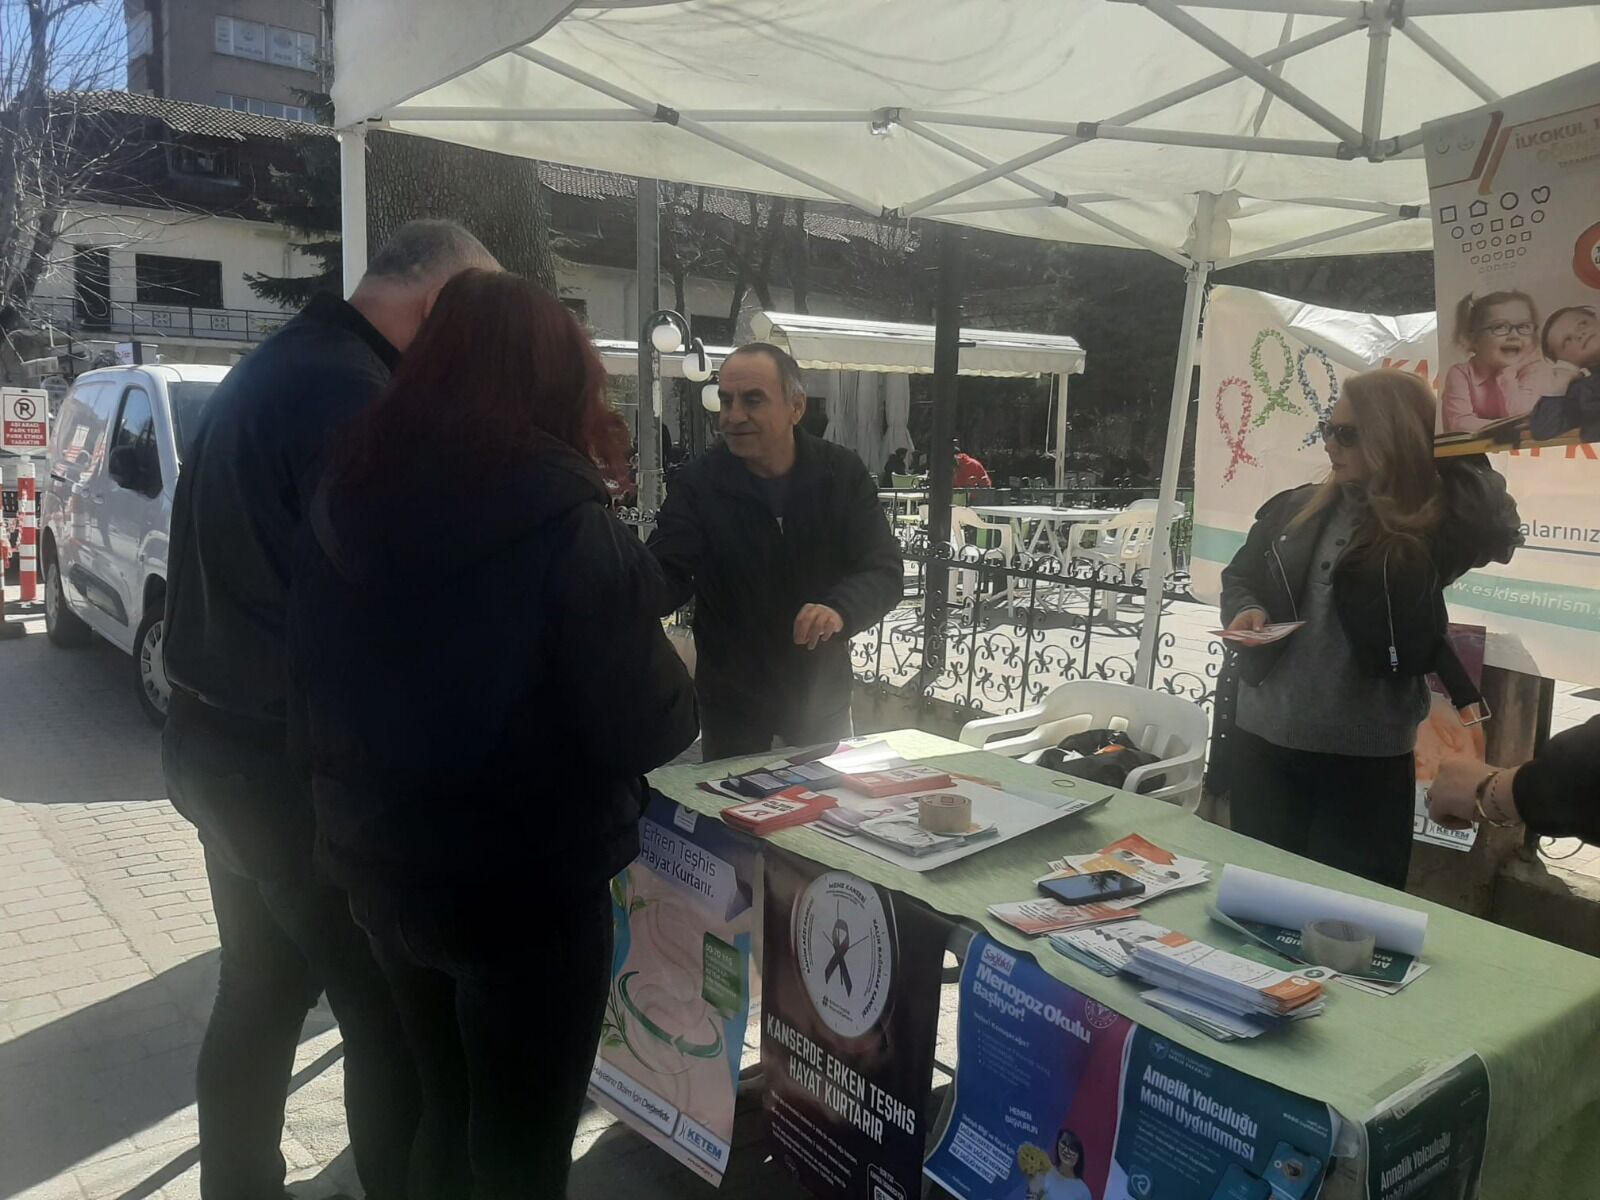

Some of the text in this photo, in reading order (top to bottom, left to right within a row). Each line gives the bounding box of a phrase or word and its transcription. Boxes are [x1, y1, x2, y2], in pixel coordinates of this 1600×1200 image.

[1515, 121, 1587, 149] İLKOKUL
[641, 843, 714, 898] Hayat Kurtarır.
[643, 822, 716, 877] Erken Teşhis
[972, 980, 1026, 1022] Başlıyor!
[976, 963, 1092, 1044] Menopoz Okulu
[766, 1012, 916, 1136] KANSERDE ERKEN TEŞHİS
[789, 1055, 822, 1097] HAYAT
[824, 1082, 884, 1145] KURTARIR
[1140, 1085, 1173, 1117] Mobil
[1175, 1103, 1255, 1162] Uygulaması
[1143, 1064, 1190, 1104] Annelik
[1192, 1088, 1258, 1140] Yolculuğu
[687, 1127, 722, 1160] KETEM
[1381, 1155, 1413, 1192] Annelik
